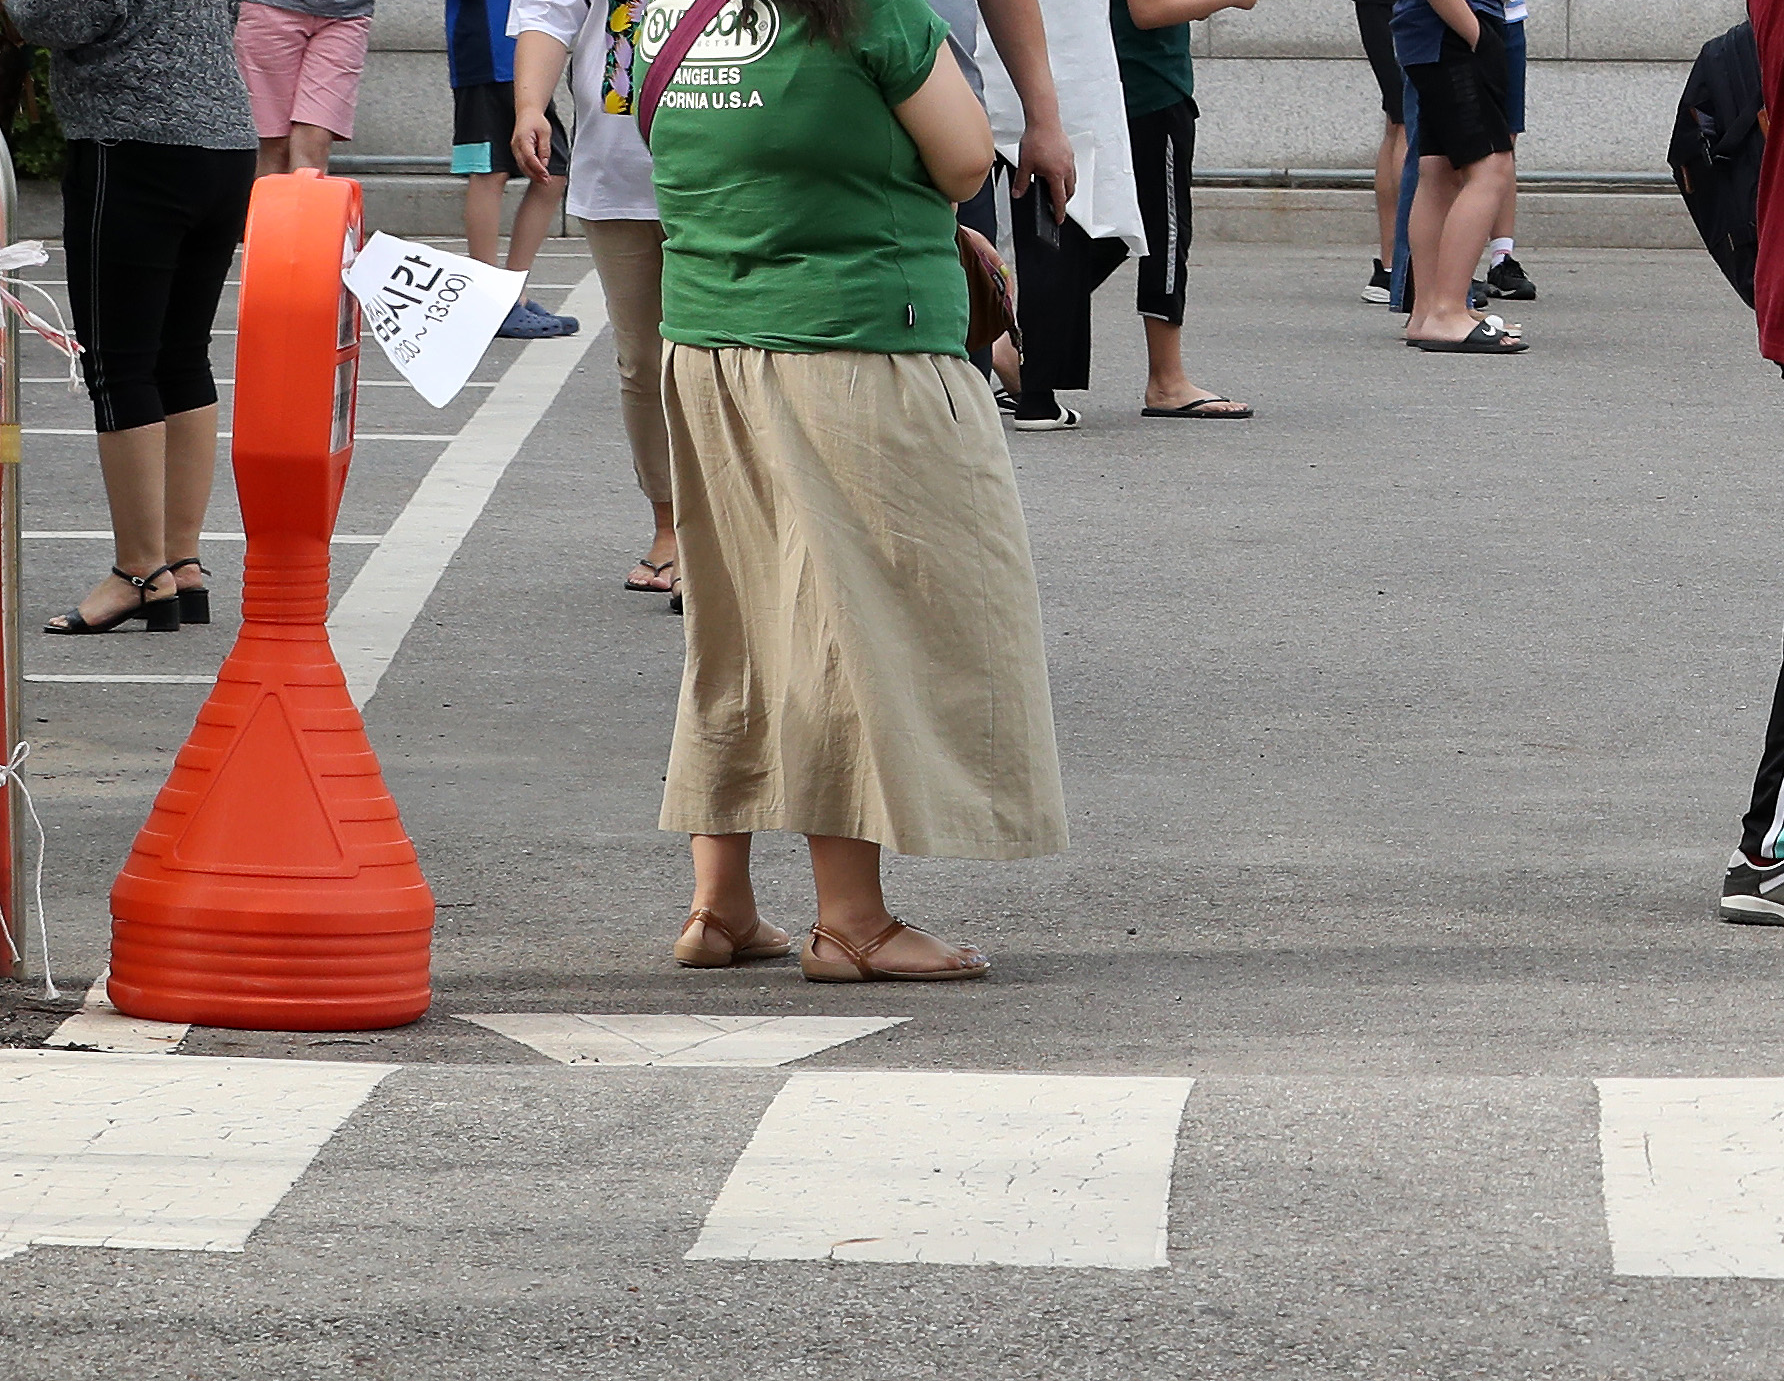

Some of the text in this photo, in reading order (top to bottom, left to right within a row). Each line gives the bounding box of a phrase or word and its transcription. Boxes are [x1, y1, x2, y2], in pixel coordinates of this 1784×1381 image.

[672, 67, 741, 86] ANGELES
[657, 90, 764, 110] FORNIA U.S.A
[423, 273, 474, 323] 13:00)
